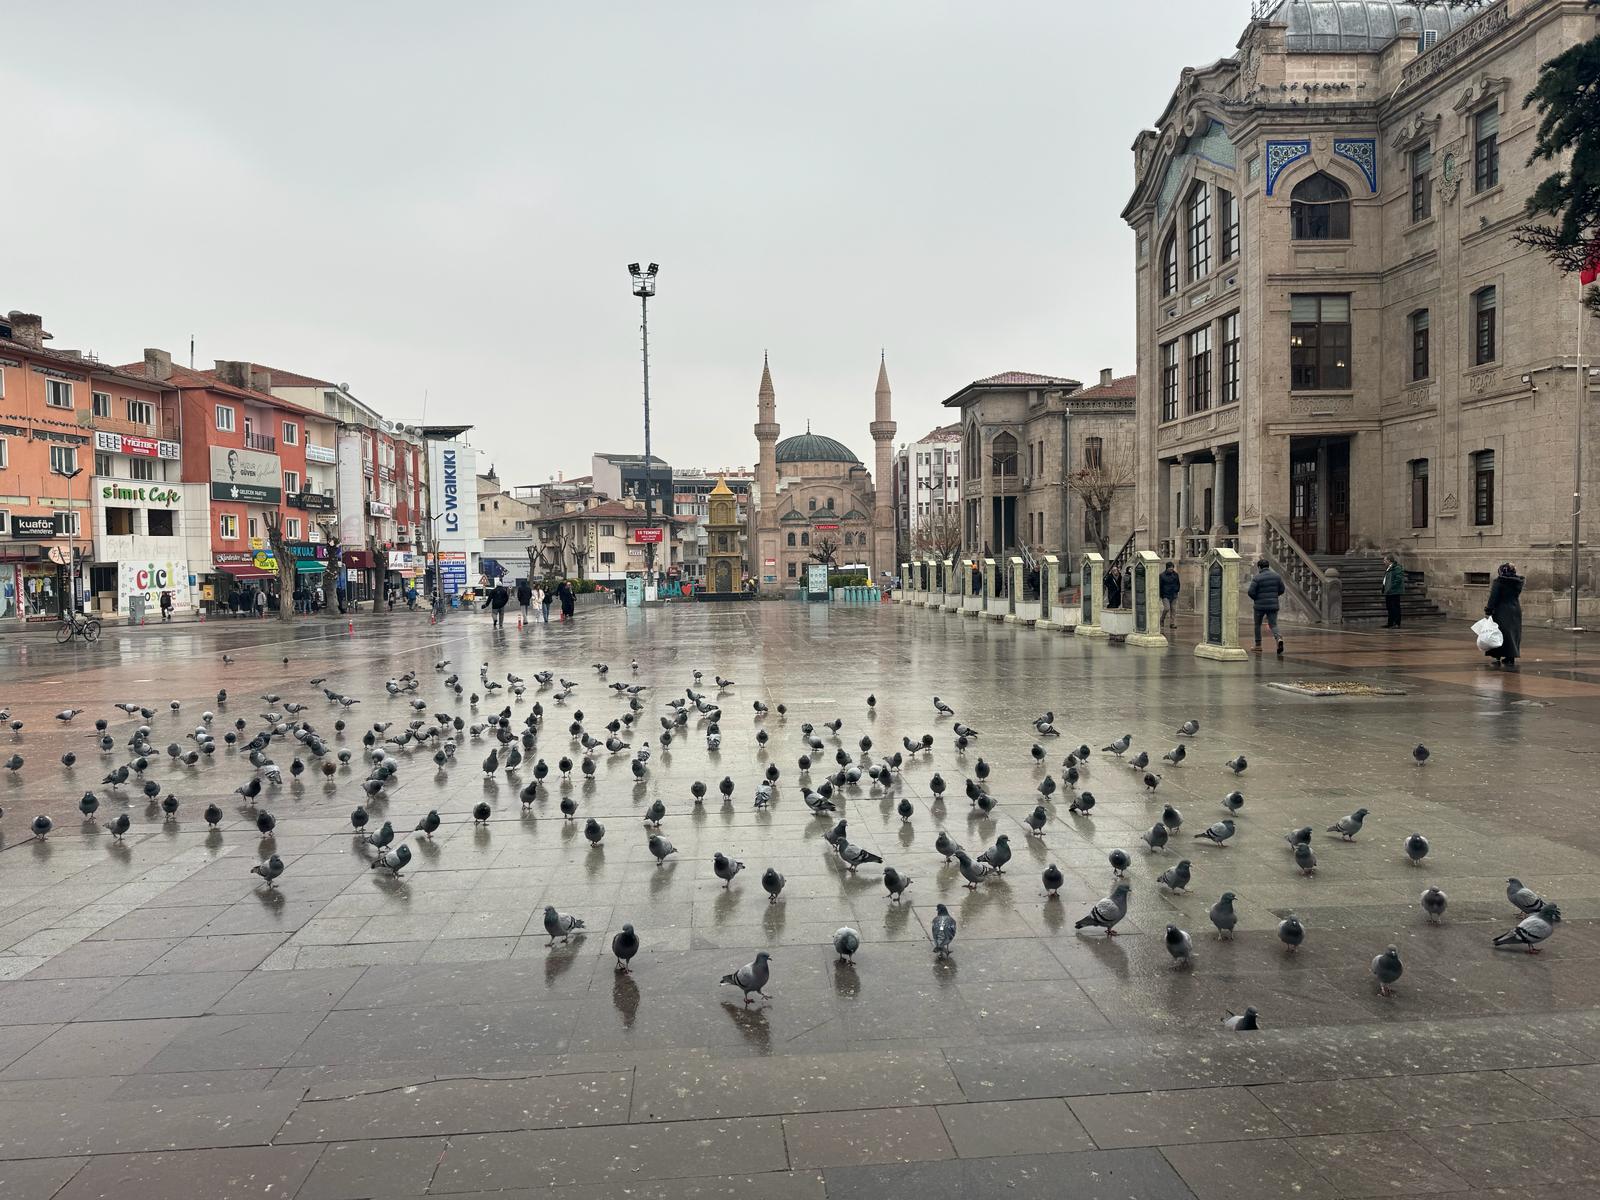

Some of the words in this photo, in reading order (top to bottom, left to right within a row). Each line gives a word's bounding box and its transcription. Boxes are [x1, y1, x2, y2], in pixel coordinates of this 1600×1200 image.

[149, 486, 181, 508] Cafe
[19, 519, 54, 529] kuaför
[446, 512, 458, 532] LC
[136, 561, 176, 590] cici
